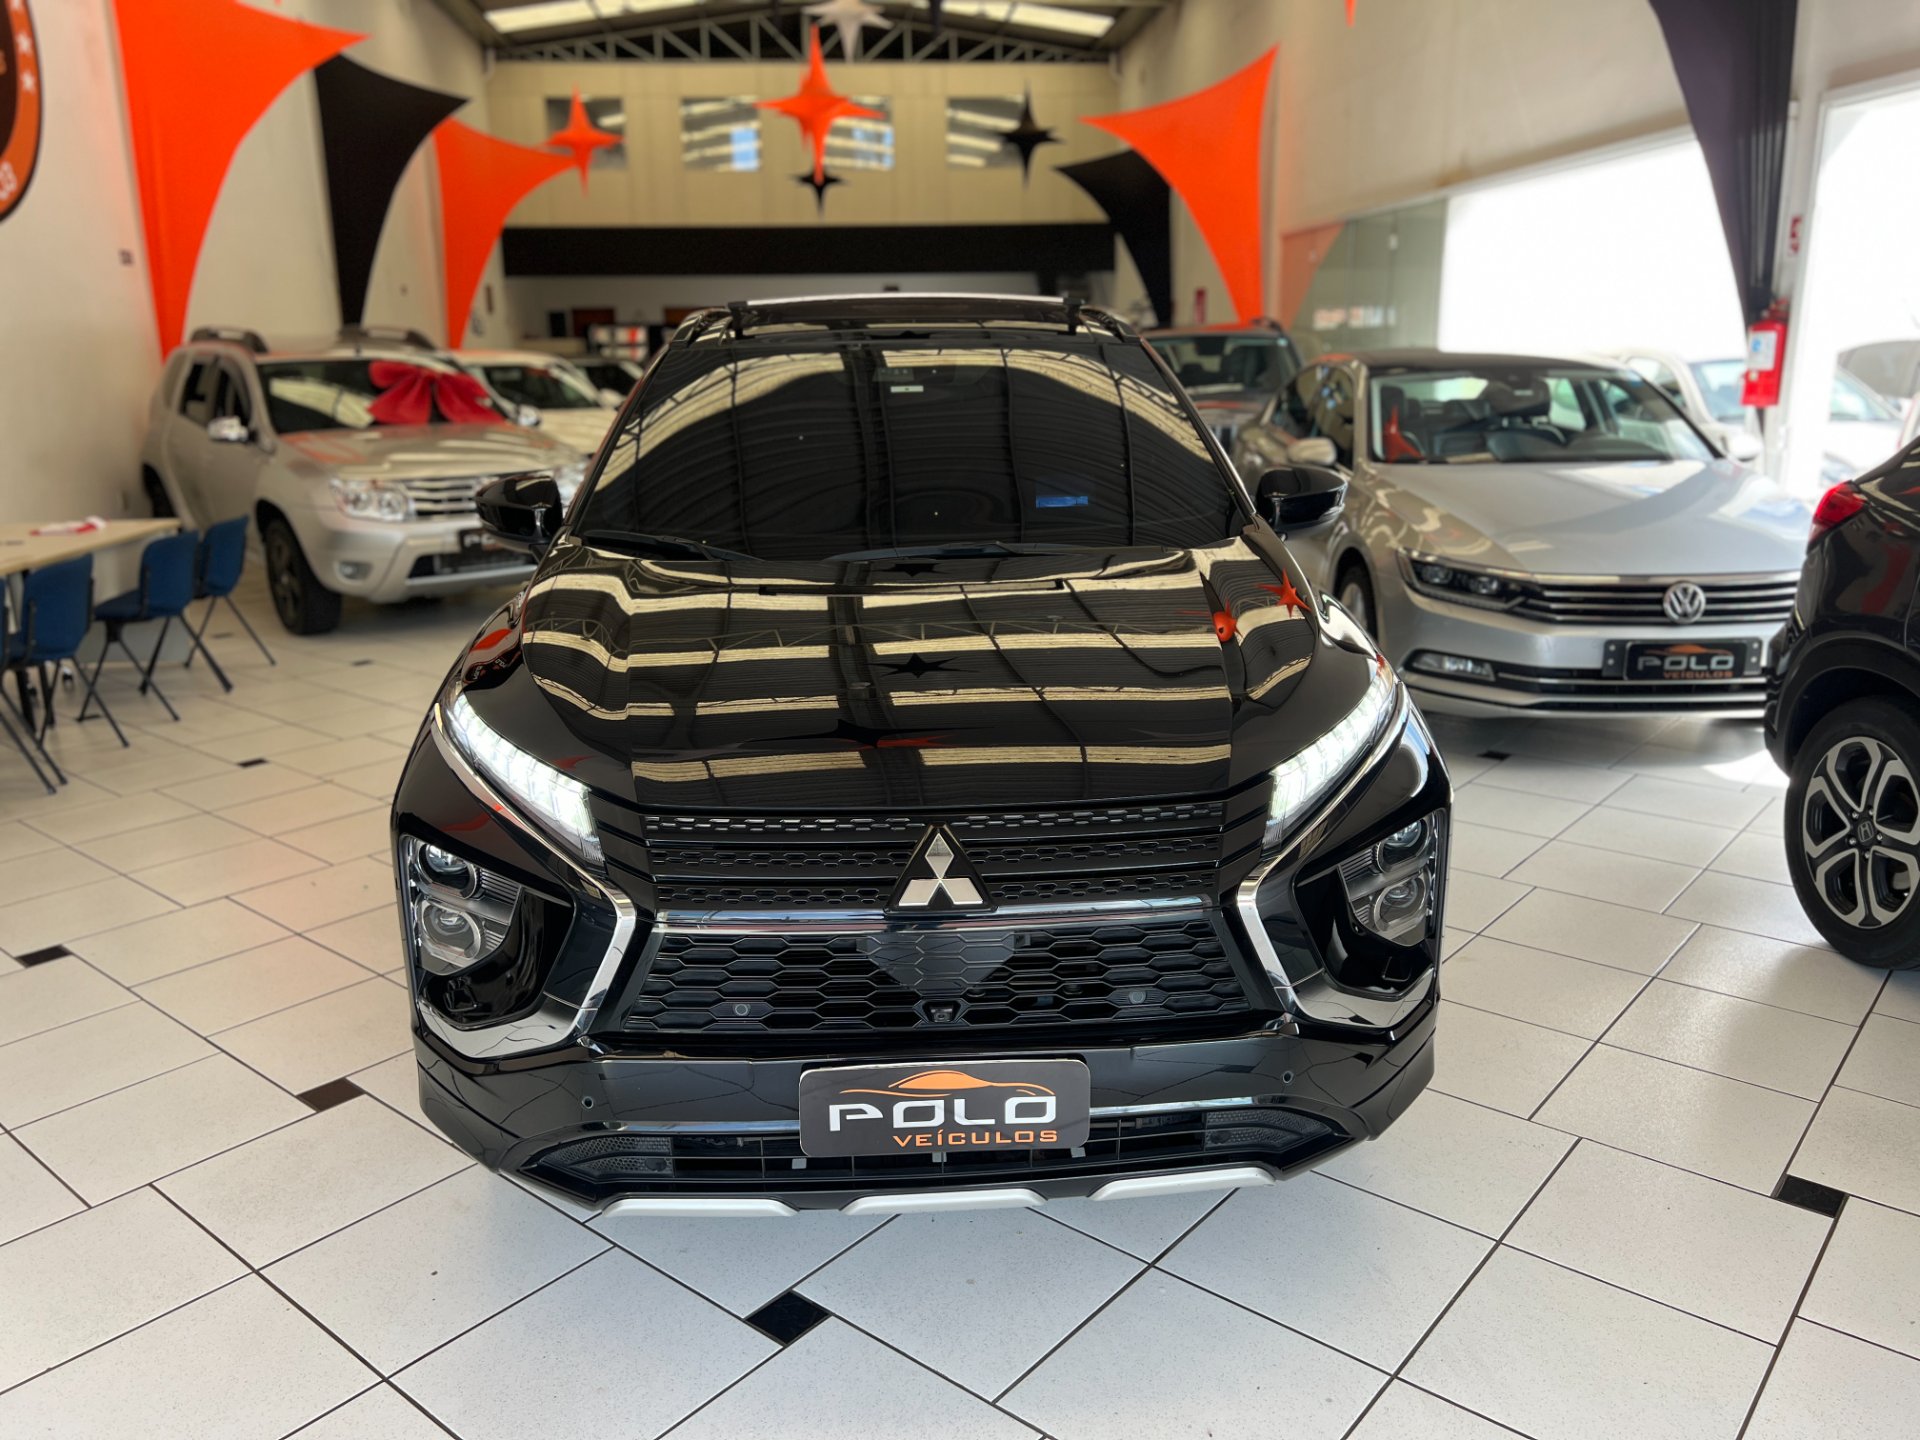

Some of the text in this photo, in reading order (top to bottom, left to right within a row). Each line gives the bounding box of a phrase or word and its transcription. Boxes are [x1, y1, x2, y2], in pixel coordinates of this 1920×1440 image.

[463, 533, 497, 548] PO
[1637, 655, 1734, 671] POLO
[829, 1096, 1057, 1132] POLO
[892, 1129, 1058, 1148] VEÍCULOS
